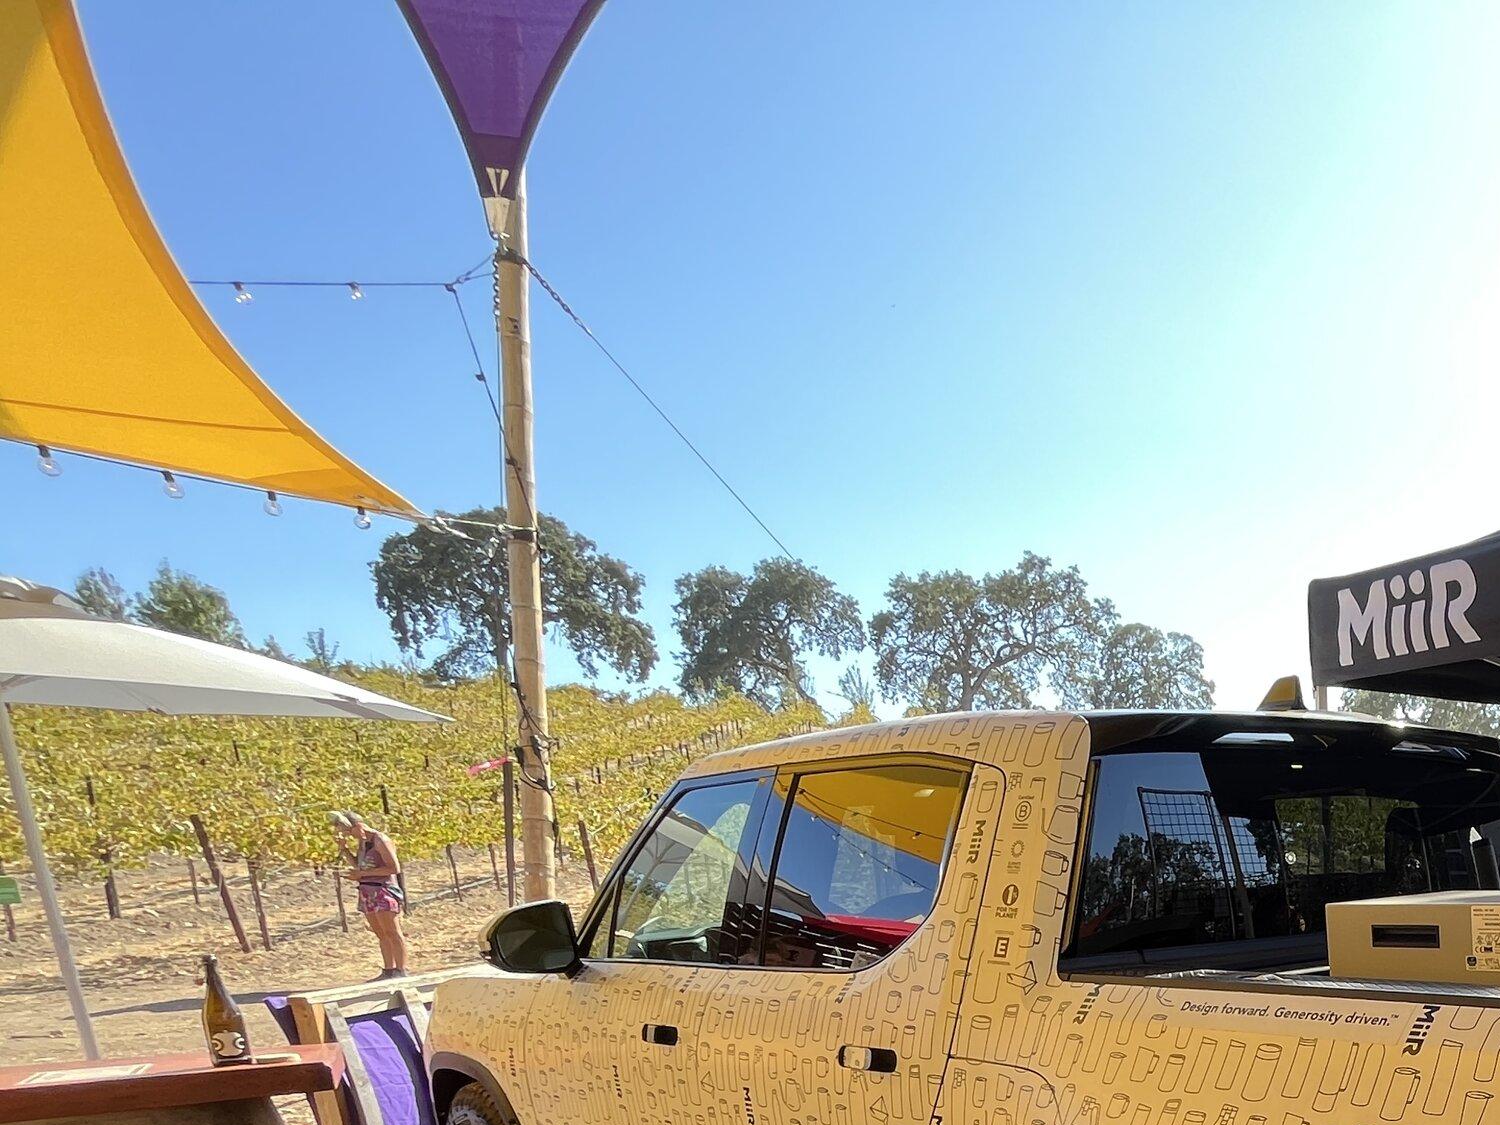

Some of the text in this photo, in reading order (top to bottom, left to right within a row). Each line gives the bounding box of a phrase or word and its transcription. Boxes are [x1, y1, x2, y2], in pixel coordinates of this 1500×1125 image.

[1337, 558, 1482, 667] MiiR
[966, 819, 987, 865] MiiR
[994, 911, 1018, 920] PLANET
[1180, 1001, 1218, 1016] Design
[1220, 1002, 1270, 1018] forward.
[1273, 1006, 1342, 1026] Generosity
[1400, 1004, 1441, 1057] MiiR
[742, 1086, 755, 1125] MiiR
